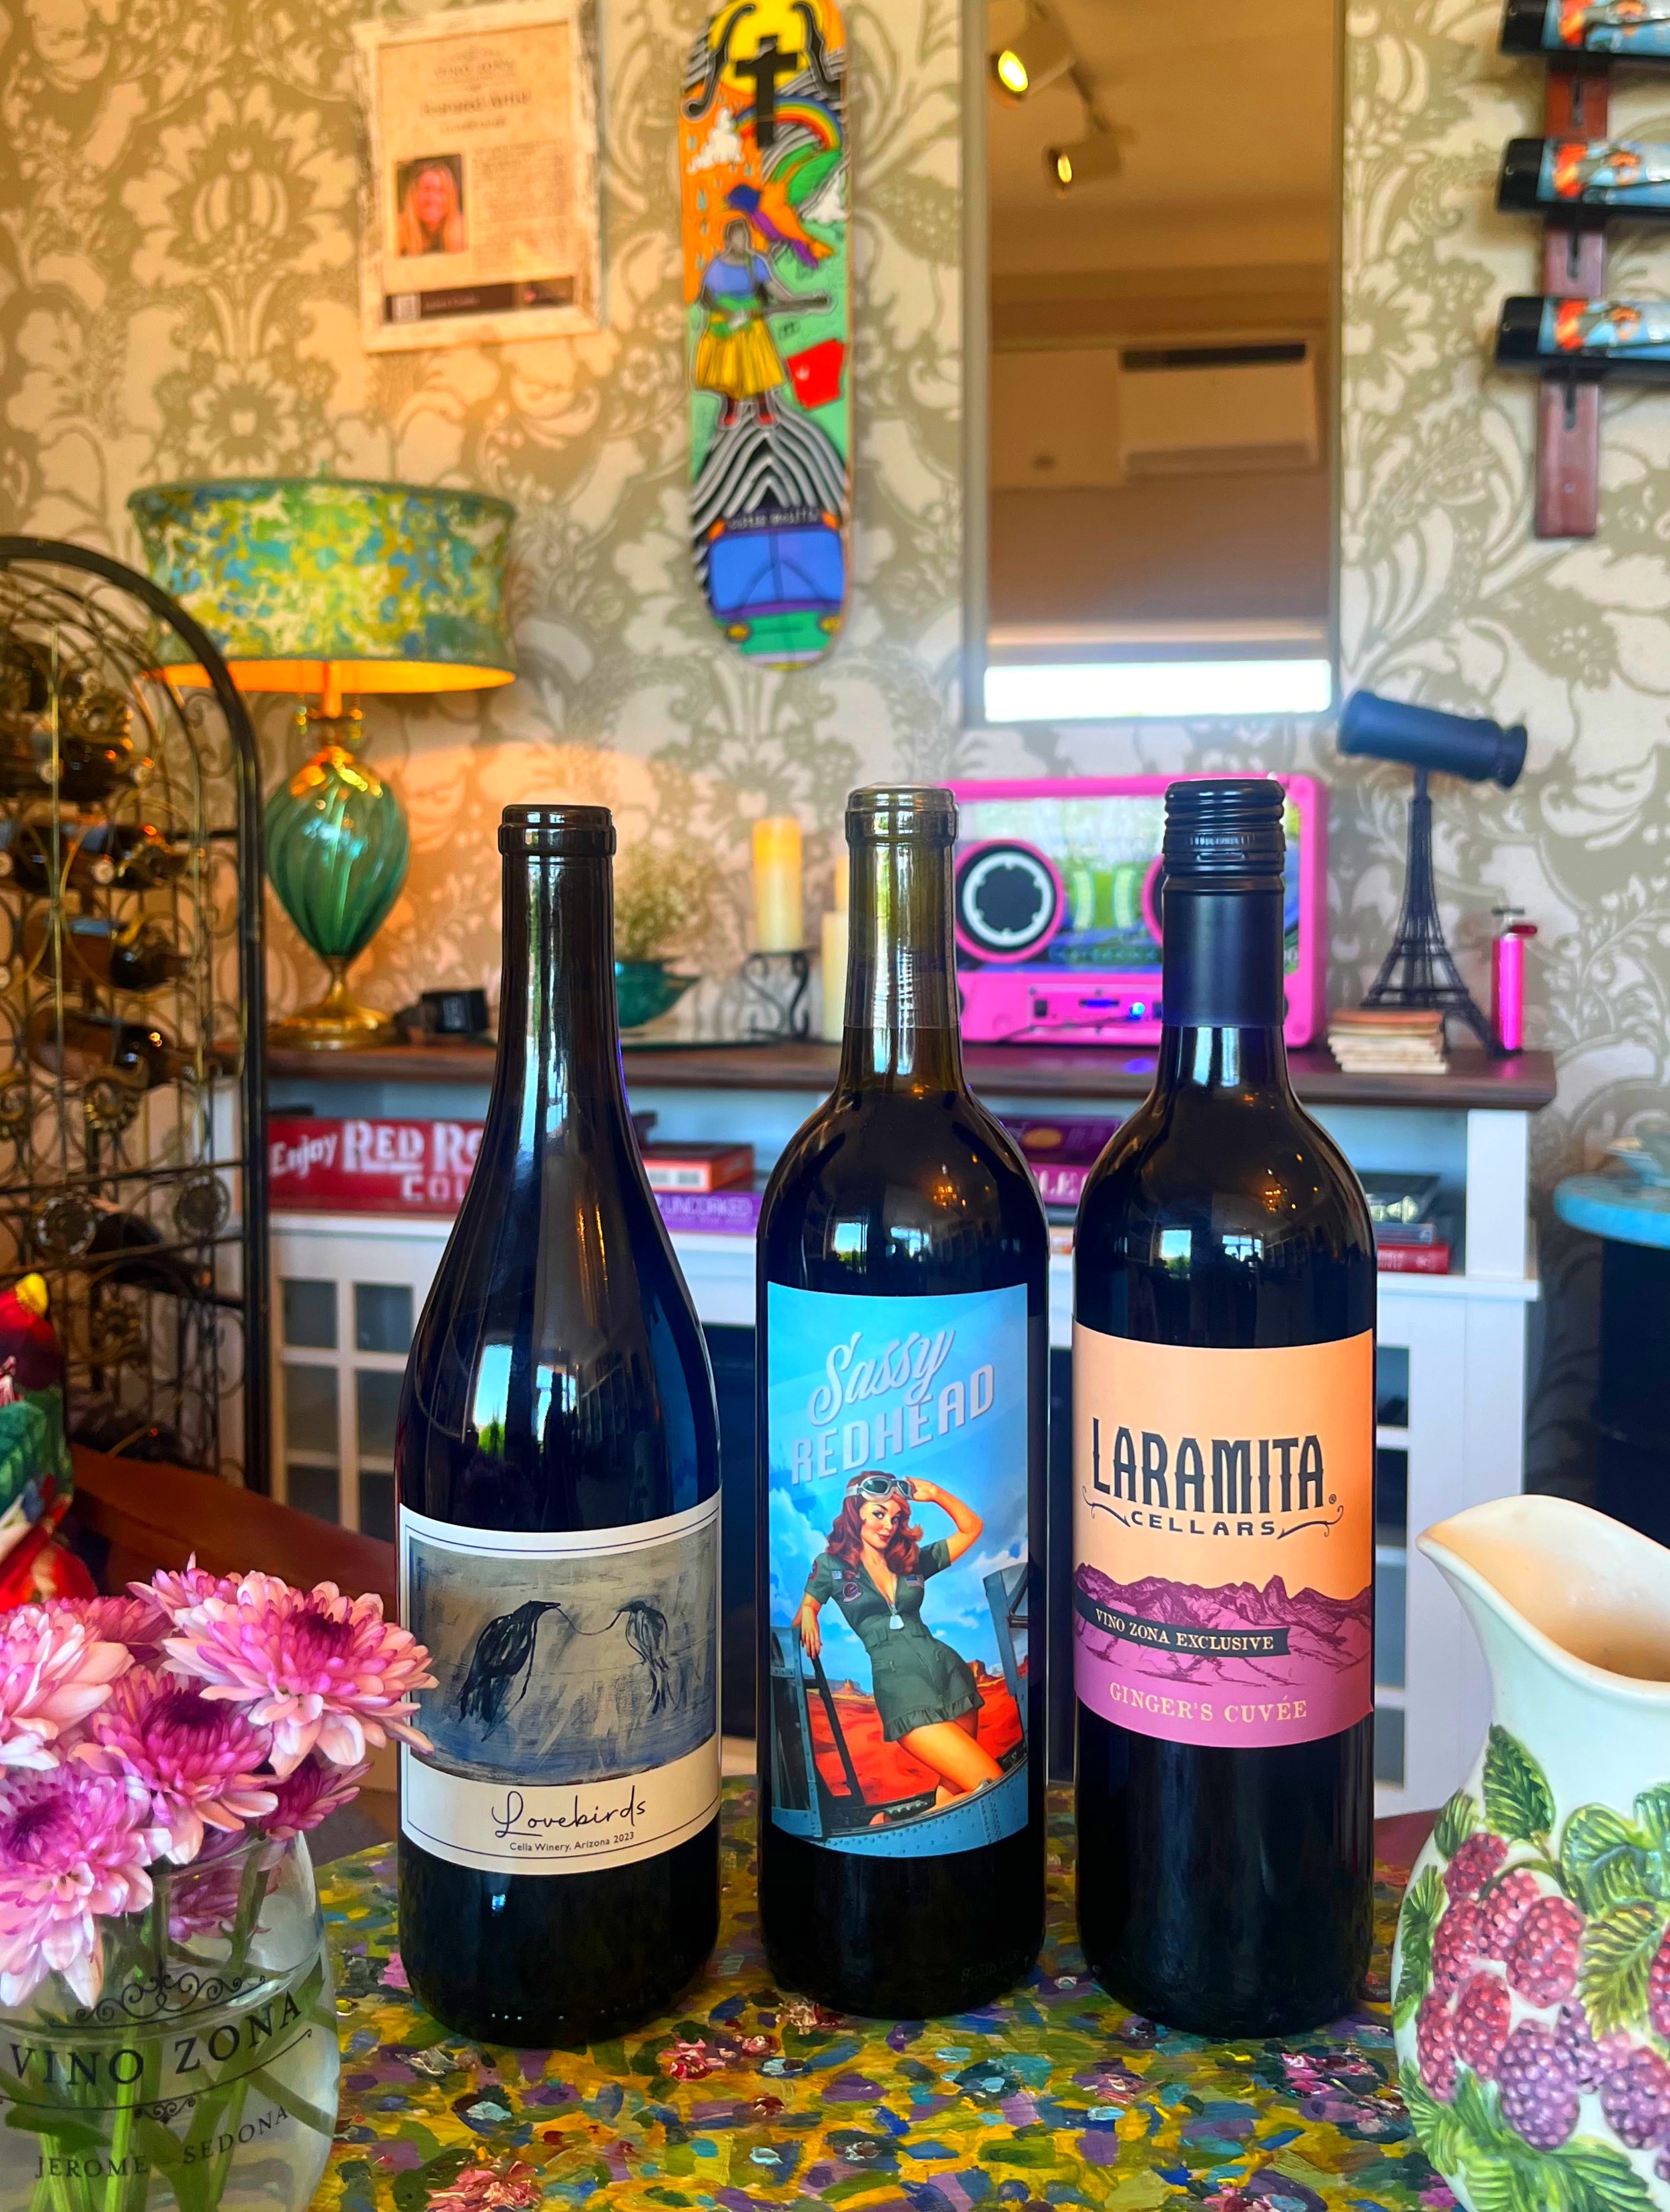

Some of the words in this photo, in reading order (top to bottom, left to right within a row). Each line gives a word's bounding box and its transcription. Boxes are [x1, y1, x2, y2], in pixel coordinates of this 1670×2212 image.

[268, 1133, 338, 1178] Enjoy
[341, 1120, 426, 1173] RED
[433, 1122, 484, 1173] RO
[402, 1174, 467, 1201] COL
[808, 1329, 956, 1427] Sassy
[791, 1363, 995, 1486] REDHEAD
[1092, 1417, 1324, 1514] LARAMITA
[1131, 1510, 1275, 1536] CELLARS
[1095, 1608, 1126, 1632] VINO
[1128, 1621, 1170, 1645] ZONA
[1176, 1632, 1274, 1651] EXCLUSIVE
[1109, 1681, 1213, 1722] GINGER'S
[1224, 1694, 1308, 1723] CUVÉE
[491, 1784, 647, 1838] Lovebirds
[509, 1842, 532, 1852] Cella
[534, 1842, 572, 1852] Winery,
[574, 1837, 610, 1850] Arizona
[612, 1831, 635, 1844] 2023
[9, 2043, 145, 2085] VINO
[174, 1990, 302, 2075] ZONA
[34, 2155, 149, 2179] JEROME
[182, 2105, 290, 2165] SEDONA
